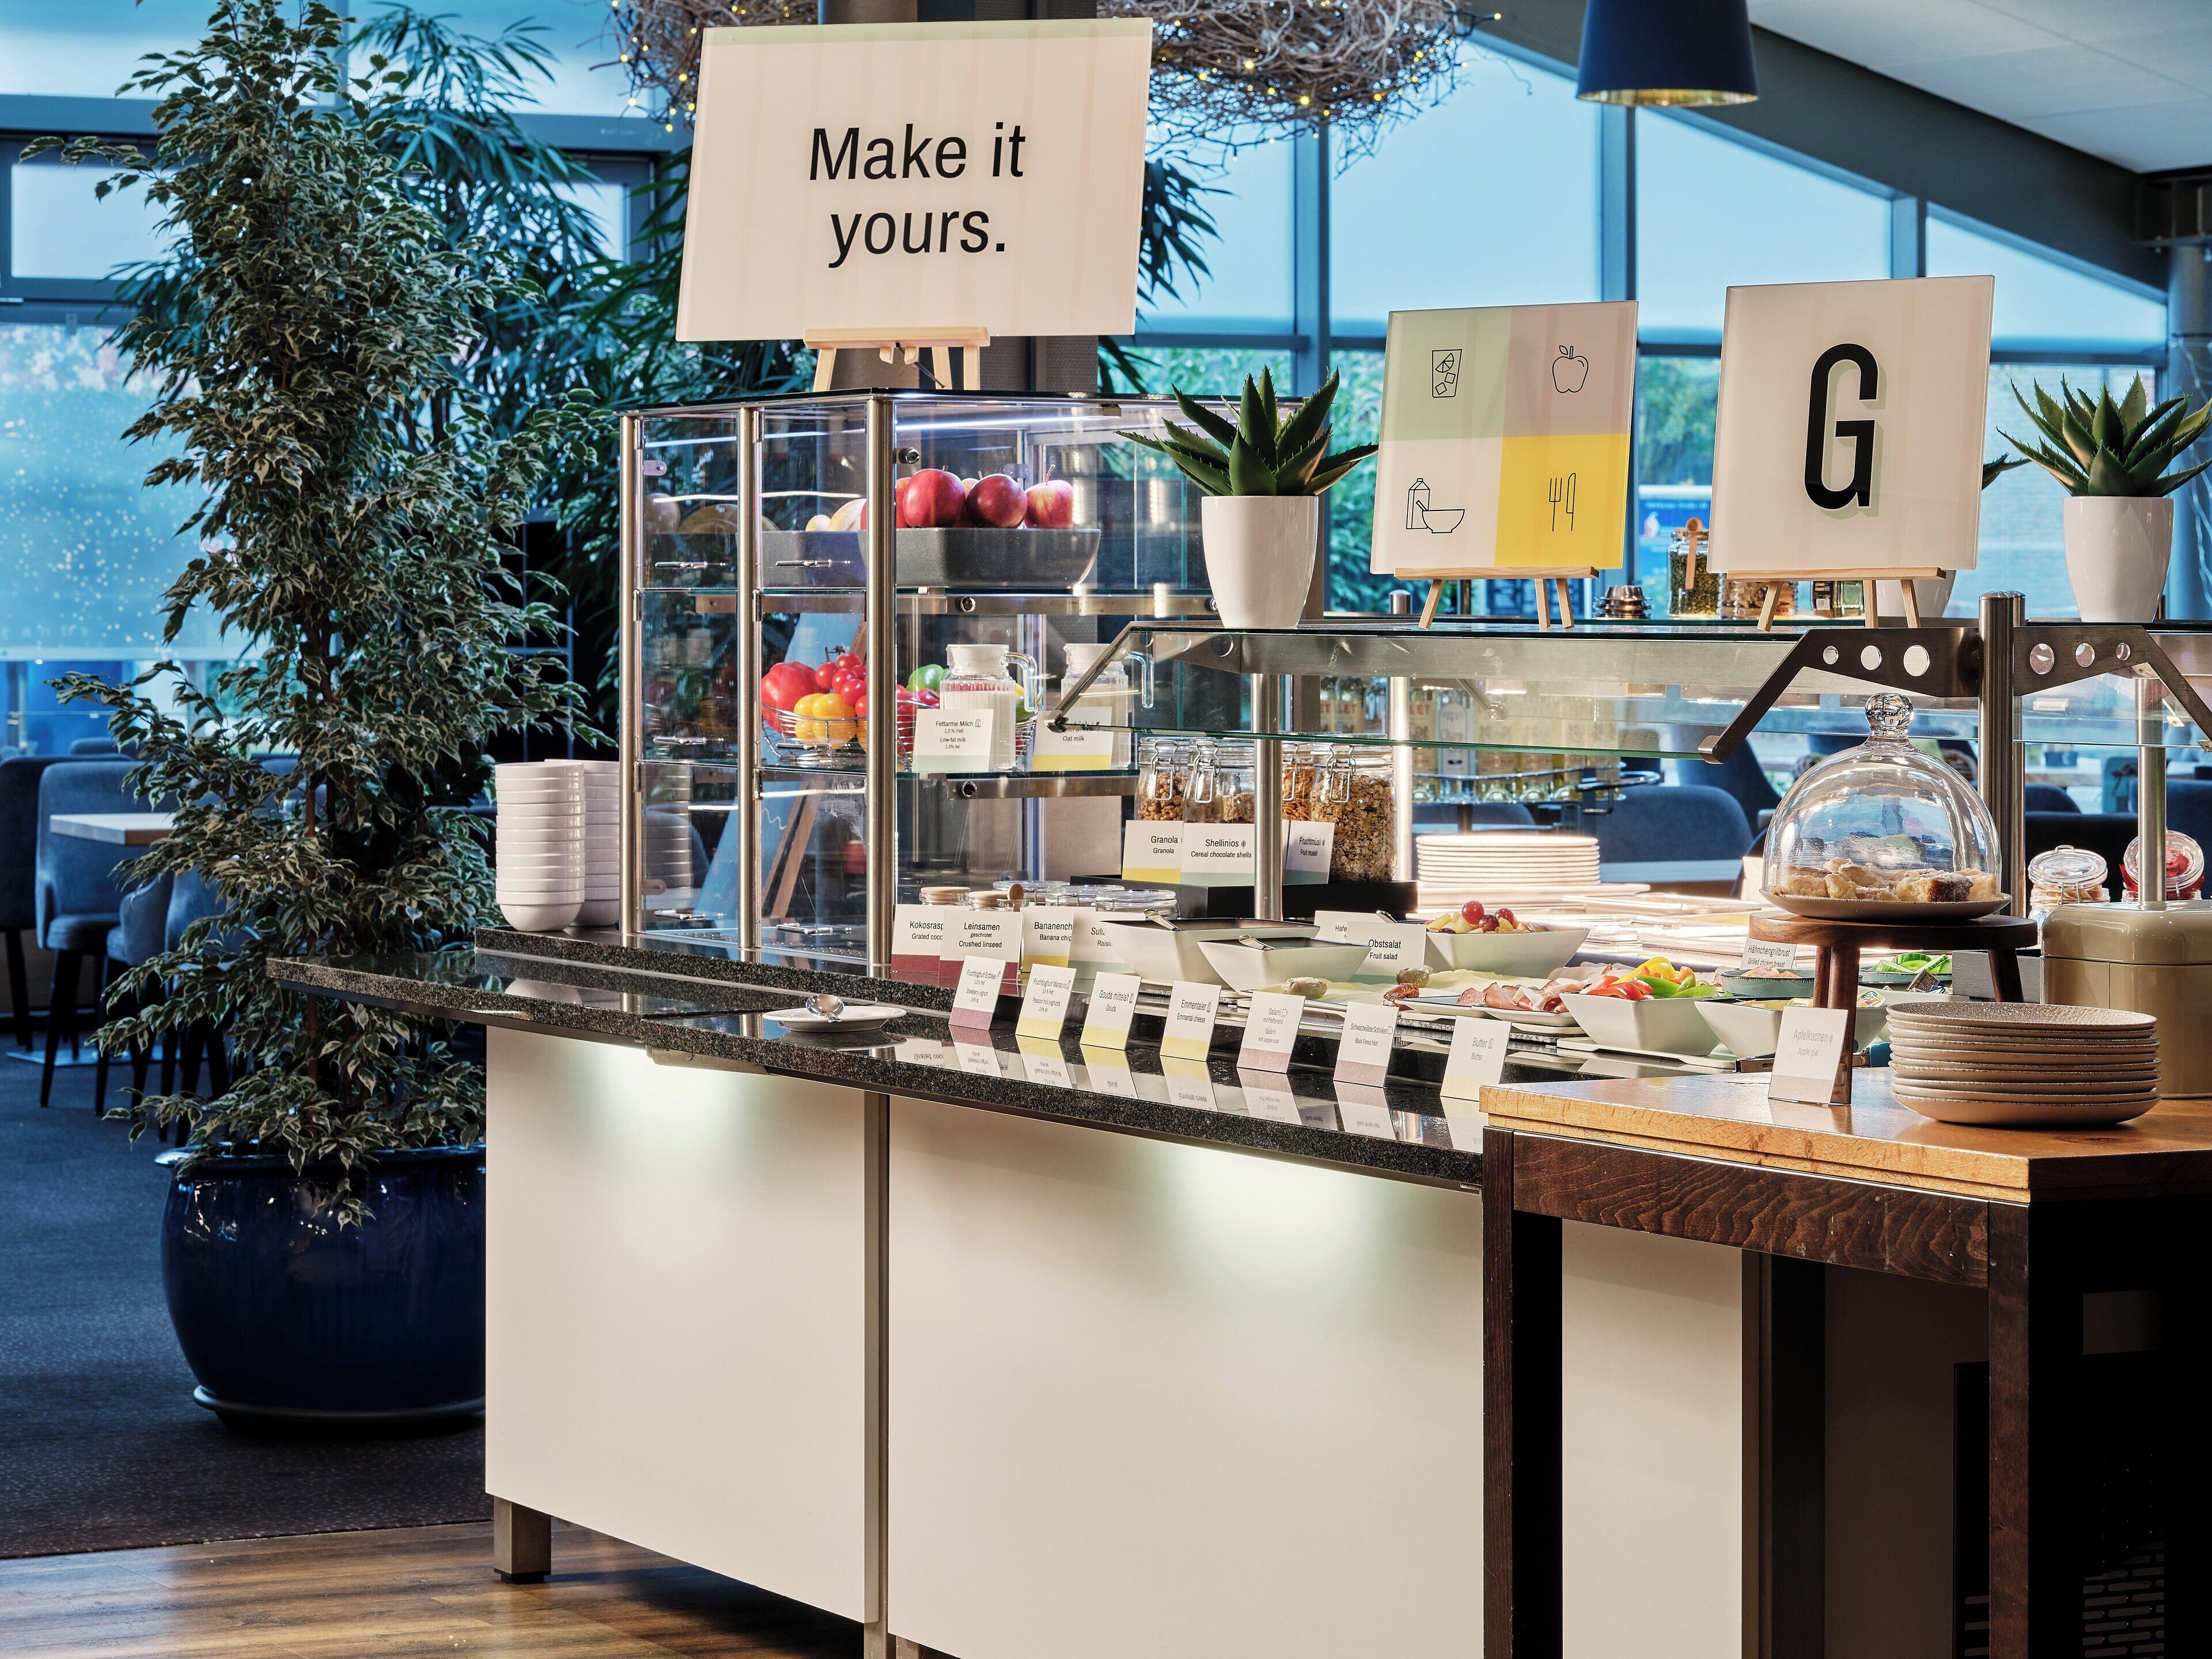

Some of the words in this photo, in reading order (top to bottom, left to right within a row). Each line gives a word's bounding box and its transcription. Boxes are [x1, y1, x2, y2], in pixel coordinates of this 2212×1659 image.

[809, 123, 967, 180] Make
[992, 122, 1026, 177] it
[828, 210, 1005, 268] yours.
[1804, 343, 1883, 514] G
[1151, 835, 1178, 843] Granola
[1205, 839, 1239, 847] Shellinios
[964, 923, 1000, 931] Leinsamen
[1034, 922, 1072, 931] Bananench
[1369, 939, 1401, 948] Obstsalat
[1748, 945, 1790, 957] Hähnchengrillbrust
[1033, 978, 1053, 988] Fruchtjoghurt
[1099, 990, 1113, 999] Gouda
[1113, 991, 1130, 1002] mittelalt
[1106, 1004, 1116, 1012] Gouda
[1181, 999, 1206, 1010] Emmentaler
[1268, 1007, 1282, 1016] Salami
[1177, 1013, 1194, 1022] Emmental
[1194, 1015, 1206, 1023] cheese
[1350, 1023, 1373, 1032] Schwarzwälder
[1373, 1026, 1387, 1035] Schinken
[1793, 1029, 1828, 1042] Apfelkuchen
[1472, 1037, 1488, 1048] Butter
[1471, 1052, 1483, 1060] Butter
[1797, 1047, 1810, 1058] Apple
[1810, 1048, 1819, 1058] pie
